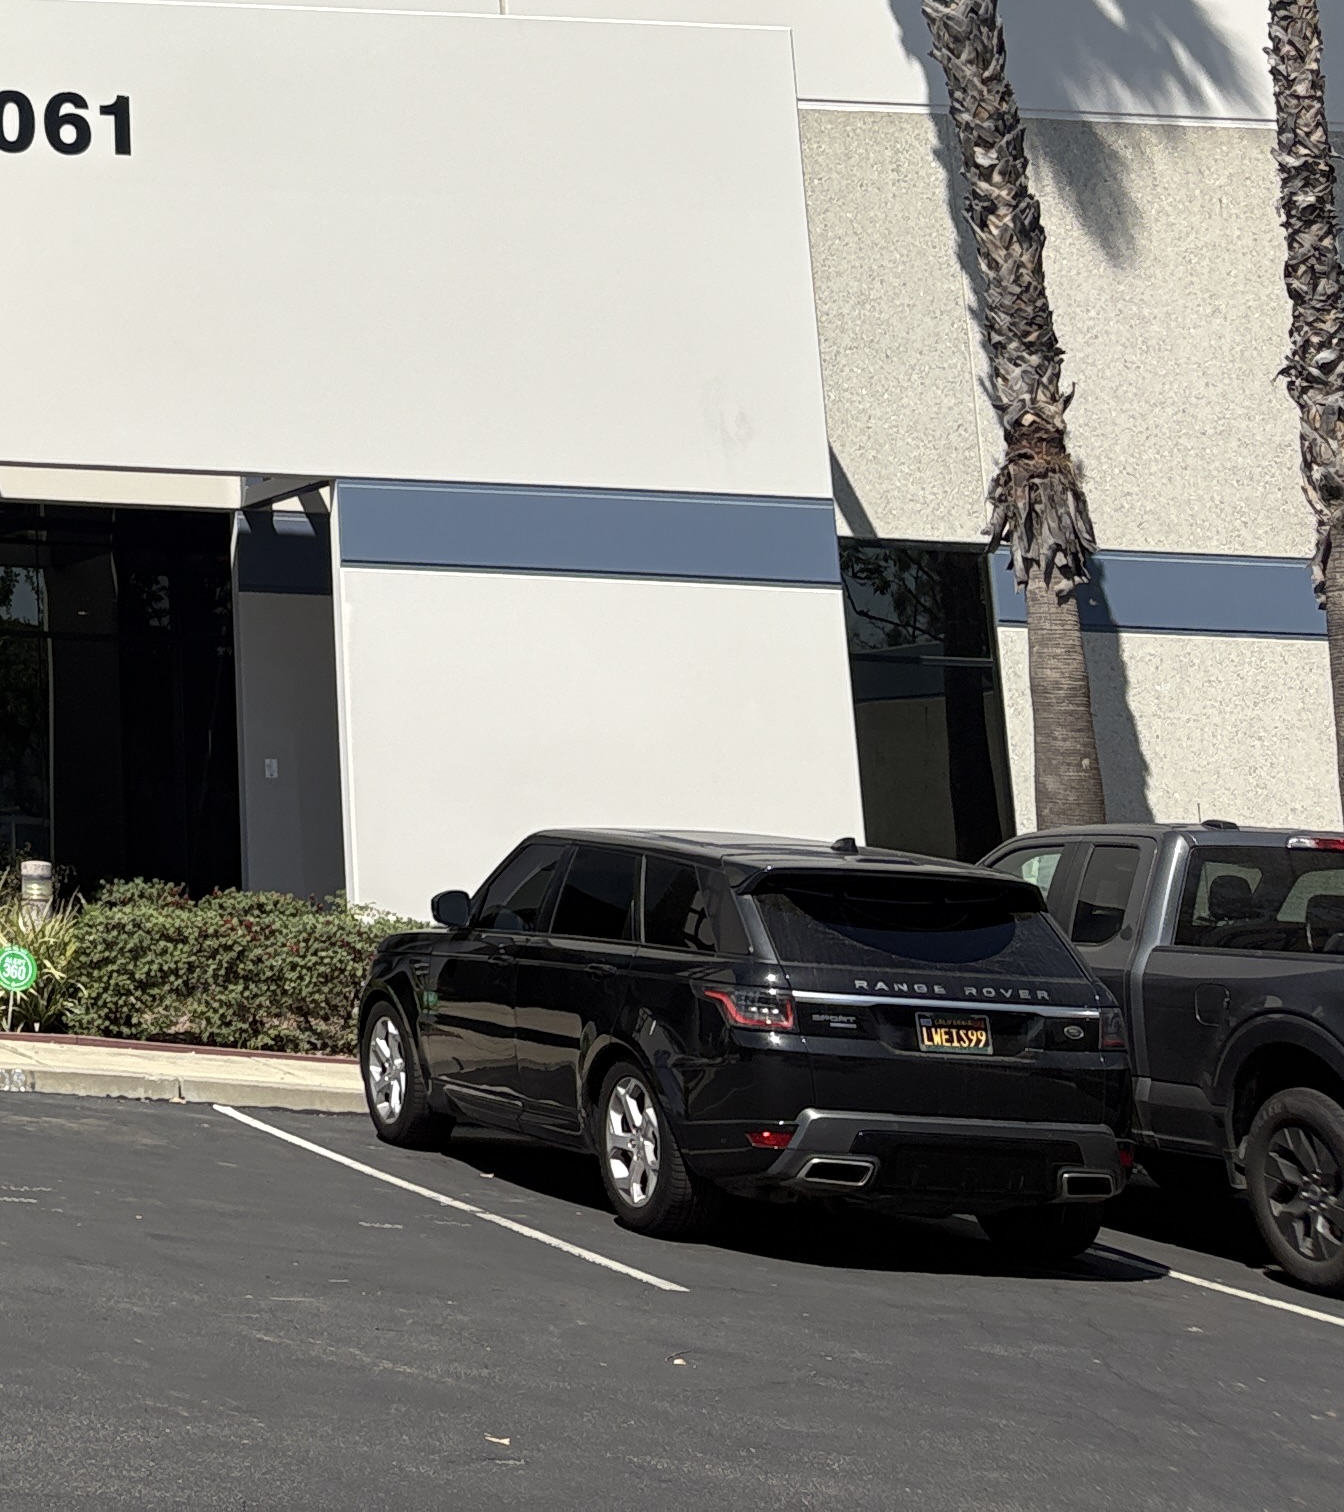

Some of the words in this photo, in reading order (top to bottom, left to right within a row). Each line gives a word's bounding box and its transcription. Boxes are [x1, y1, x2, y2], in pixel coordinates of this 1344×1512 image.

[2, 963, 26, 981] 360
[854, 980, 947, 995] RANGE
[964, 987, 1051, 1001] ROVER
[922, 1027, 987, 1049] LWEIS99
